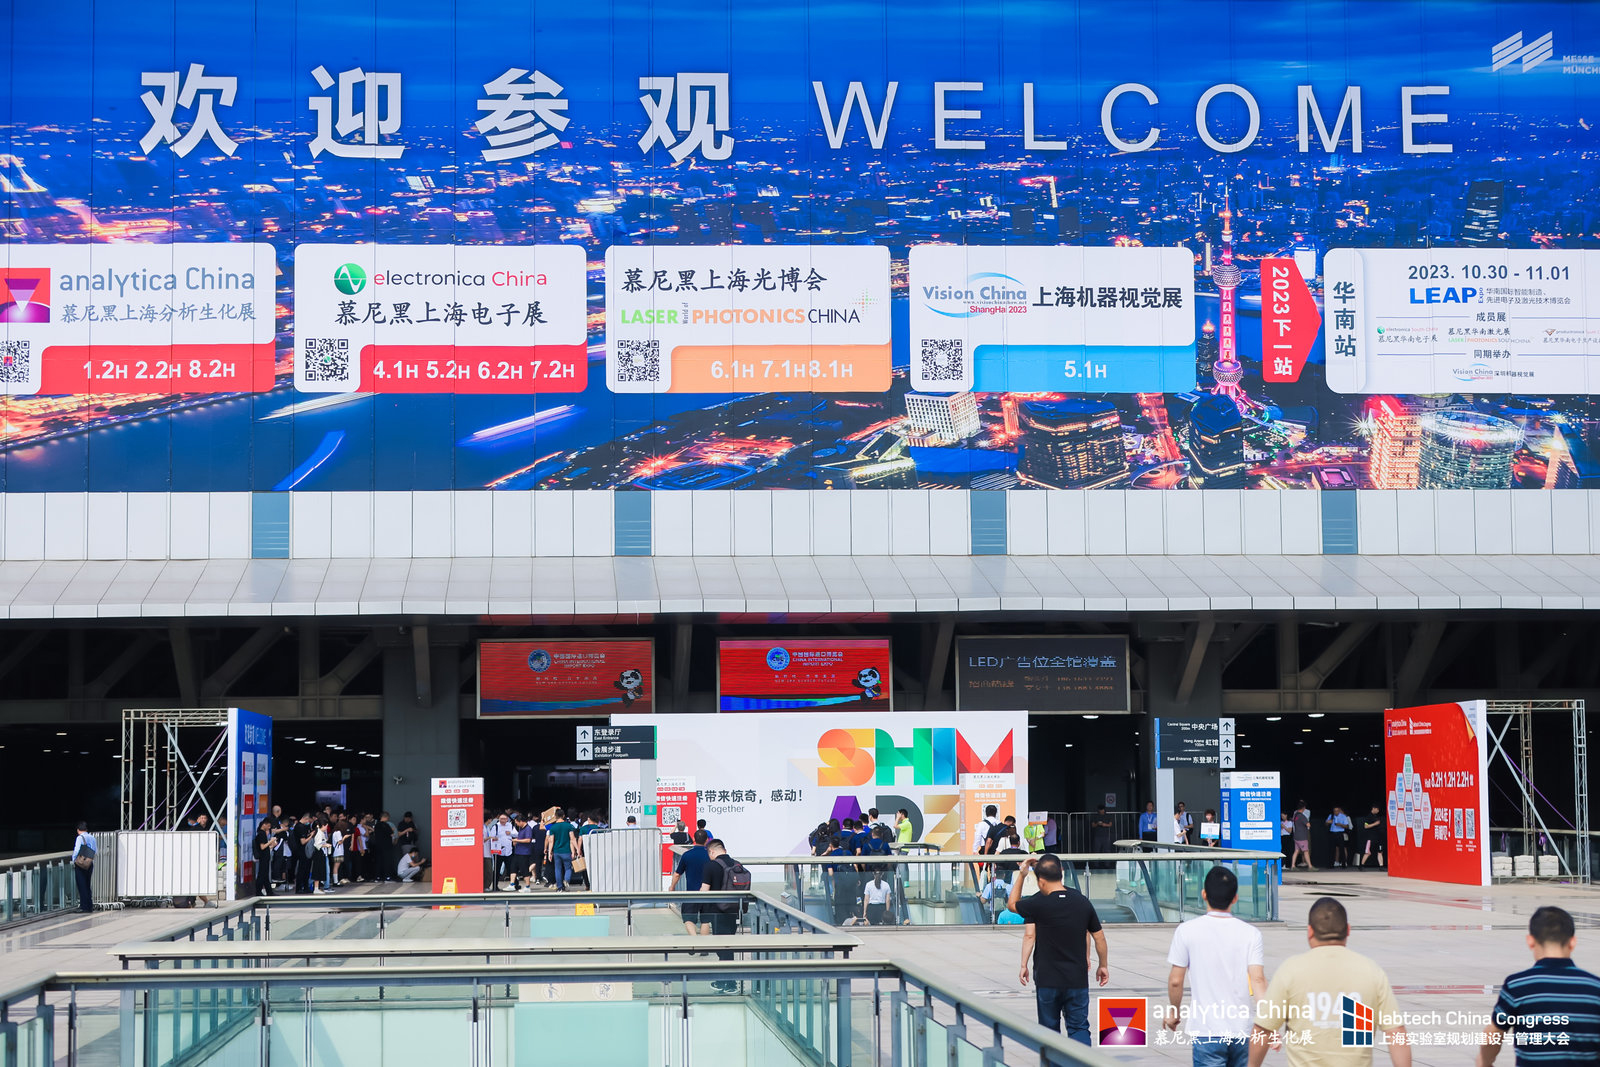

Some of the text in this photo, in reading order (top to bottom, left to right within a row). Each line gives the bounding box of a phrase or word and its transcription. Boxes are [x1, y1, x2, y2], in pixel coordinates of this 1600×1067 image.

[140, 62, 734, 162] 欢迎参观
[812, 81, 1455, 154] WELCOME
[374, 270, 547, 287] electronica China
[621, 267, 828, 293] 慕尼黑上海光博会
[1408, 265, 1455, 279] 2023.
[1462, 265, 1508, 279] 10.30
[1526, 266, 1570, 280] 11.01
[60, 267, 255, 297] analytica China
[922, 285, 1027, 300] Vision China
[1032, 286, 1182, 309] 上海机器视觉展
[1410, 287, 1477, 304] LEAP
[60, 302, 256, 323] 慕尼黑上海分析生化展
[334, 300, 548, 327] 慕尼黑上海电子展
[621, 309, 678, 324] LASER
[692, 309, 806, 324] PHOTONICS
[808, 309, 860, 324] CHINA
[1272, 266, 1293, 376] 2023下一站
[1333, 281, 1357, 357] 华南站
[1476, 312, 1506, 322] 成员展
[1474, 350, 1511, 359] 同期举办
[83, 360, 235, 379] 1.2H 2.2H 8.2H
[373, 361, 575, 379] 4.1H 5.2H 6.2H 7.2H
[711, 361, 754, 378] 6.1H
[1064, 361, 1107, 379] 5.1H
[1192, 723, 1218, 731] 中央广场
[1456, 771, 1469, 788] 2.2H
[708, 806, 745, 815] Together
